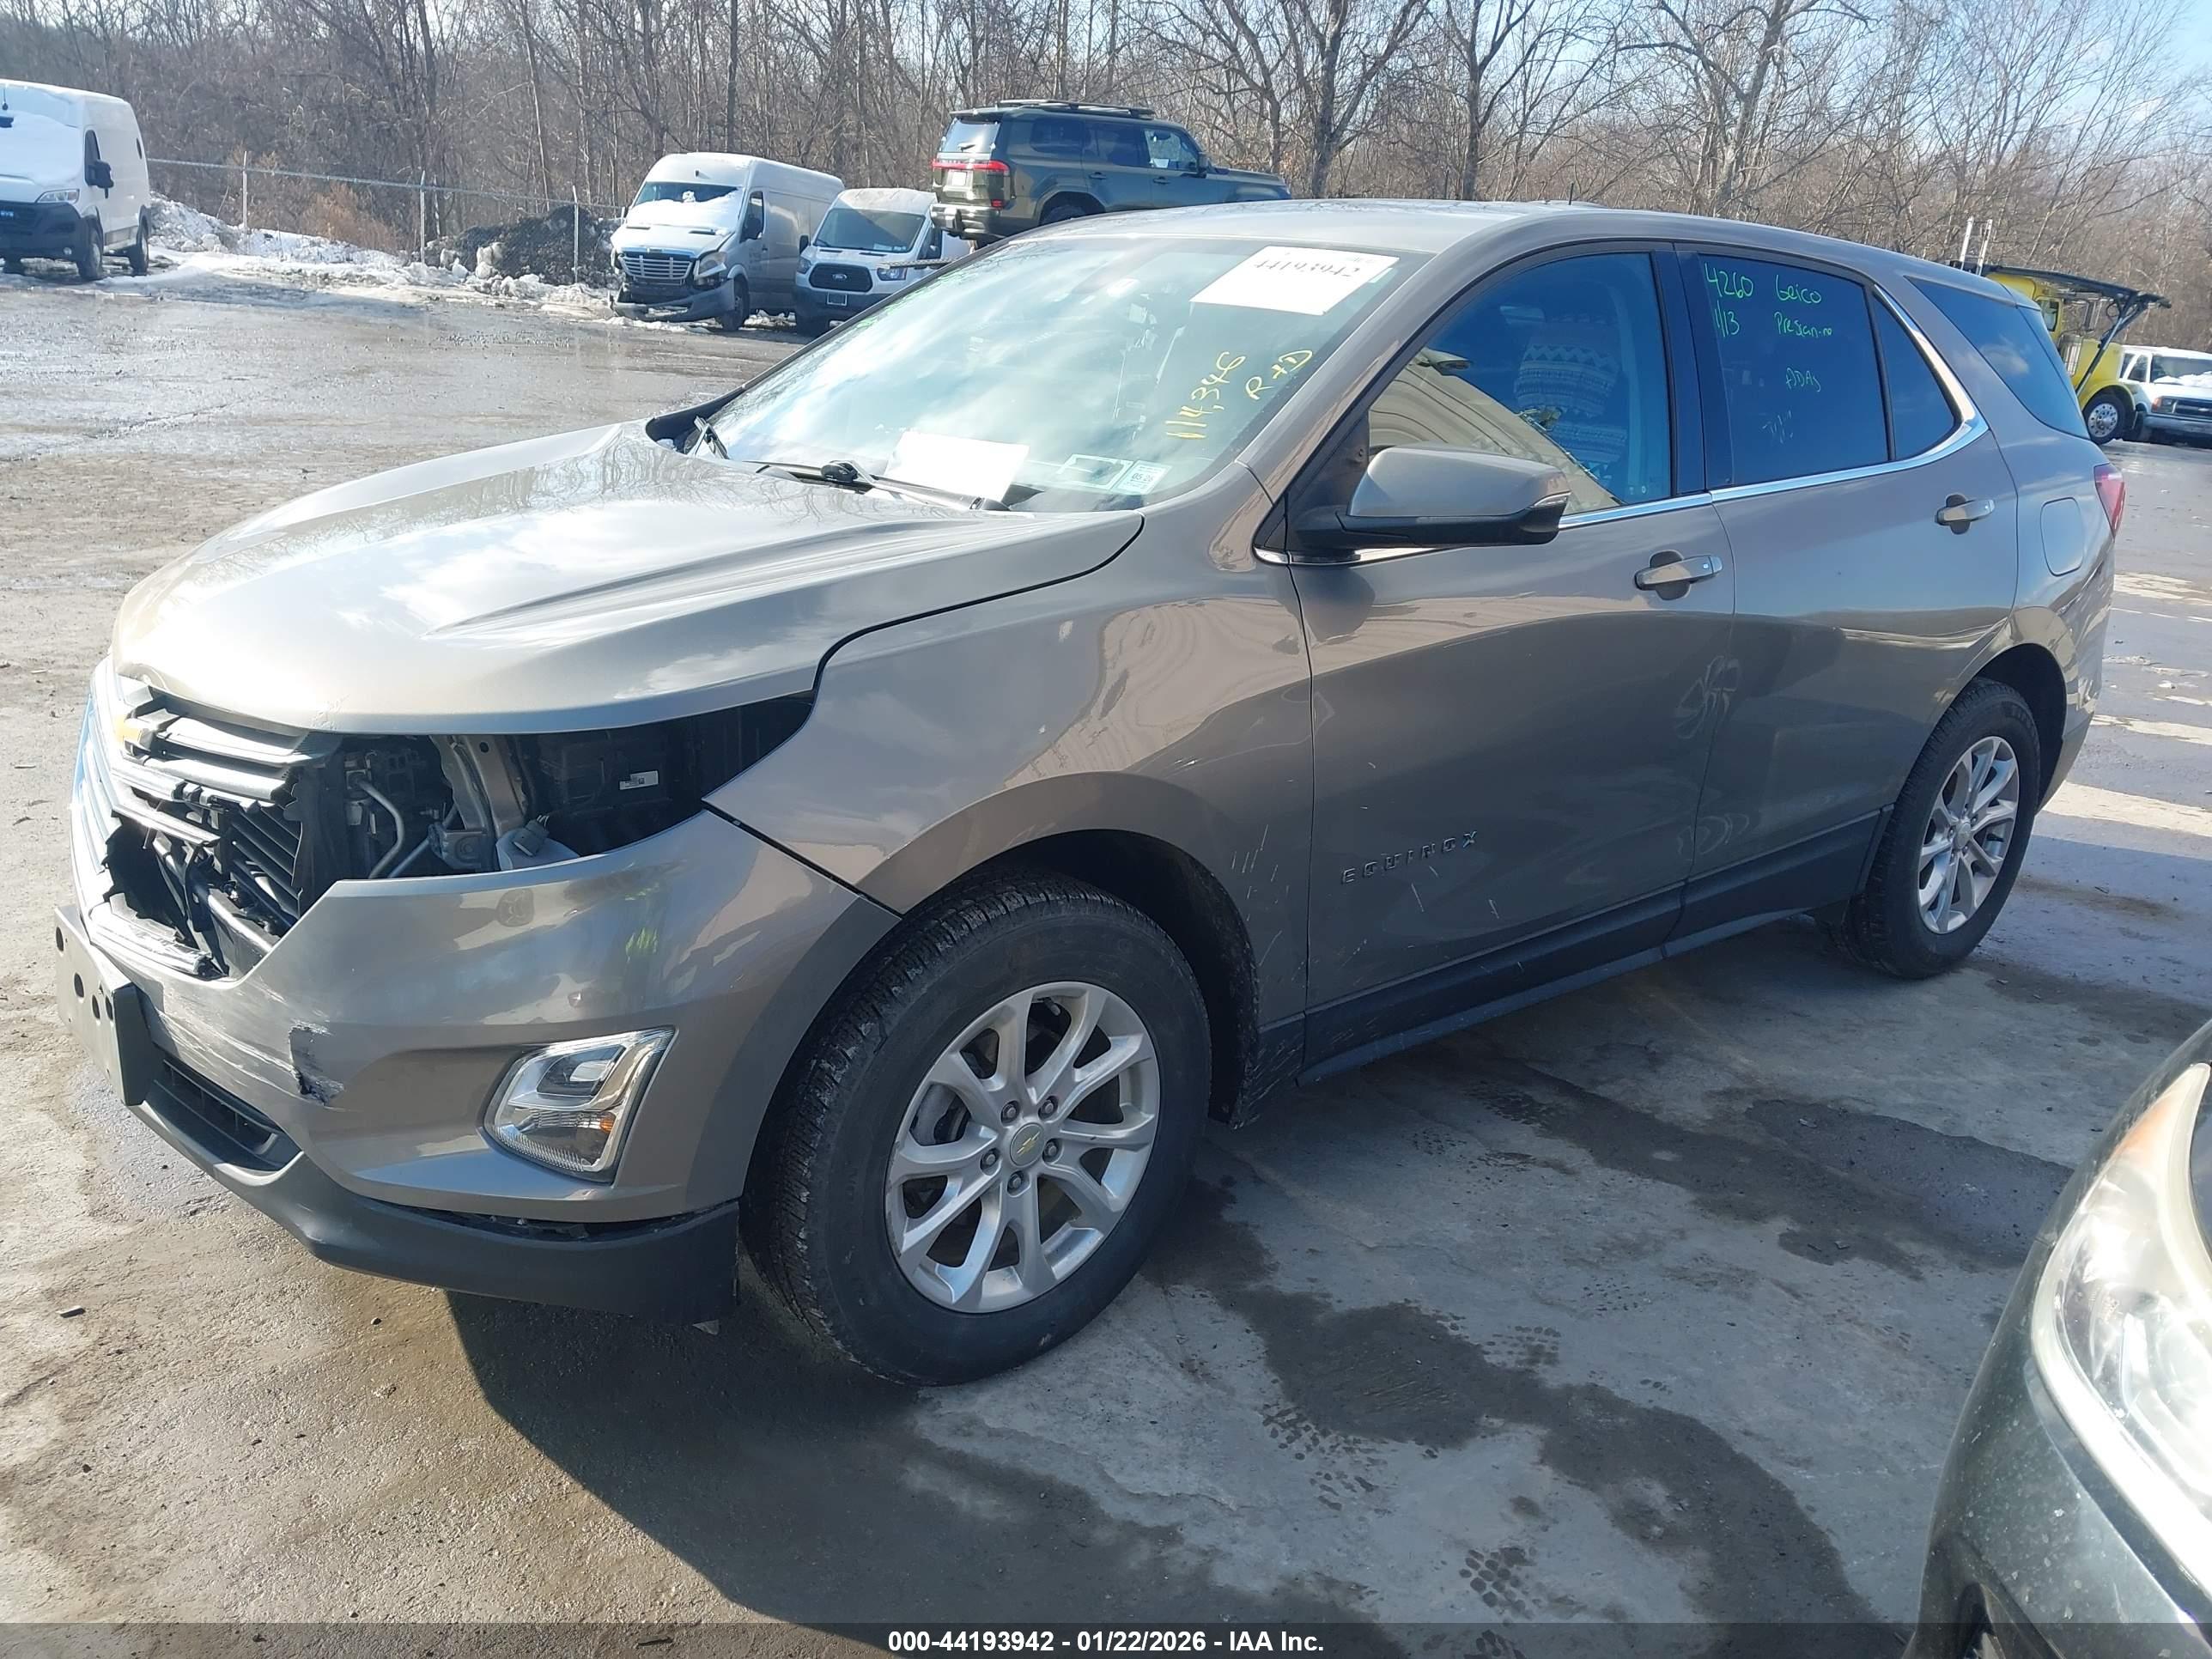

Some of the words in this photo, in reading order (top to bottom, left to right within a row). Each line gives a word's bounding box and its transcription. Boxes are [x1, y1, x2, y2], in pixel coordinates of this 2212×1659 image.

[1704, 261, 1753, 299] 4260
[1776, 274, 1822, 304] Geico
[1714, 299, 1741, 337] 1/13
[1340, 830, 1477, 884] EQUINOX
